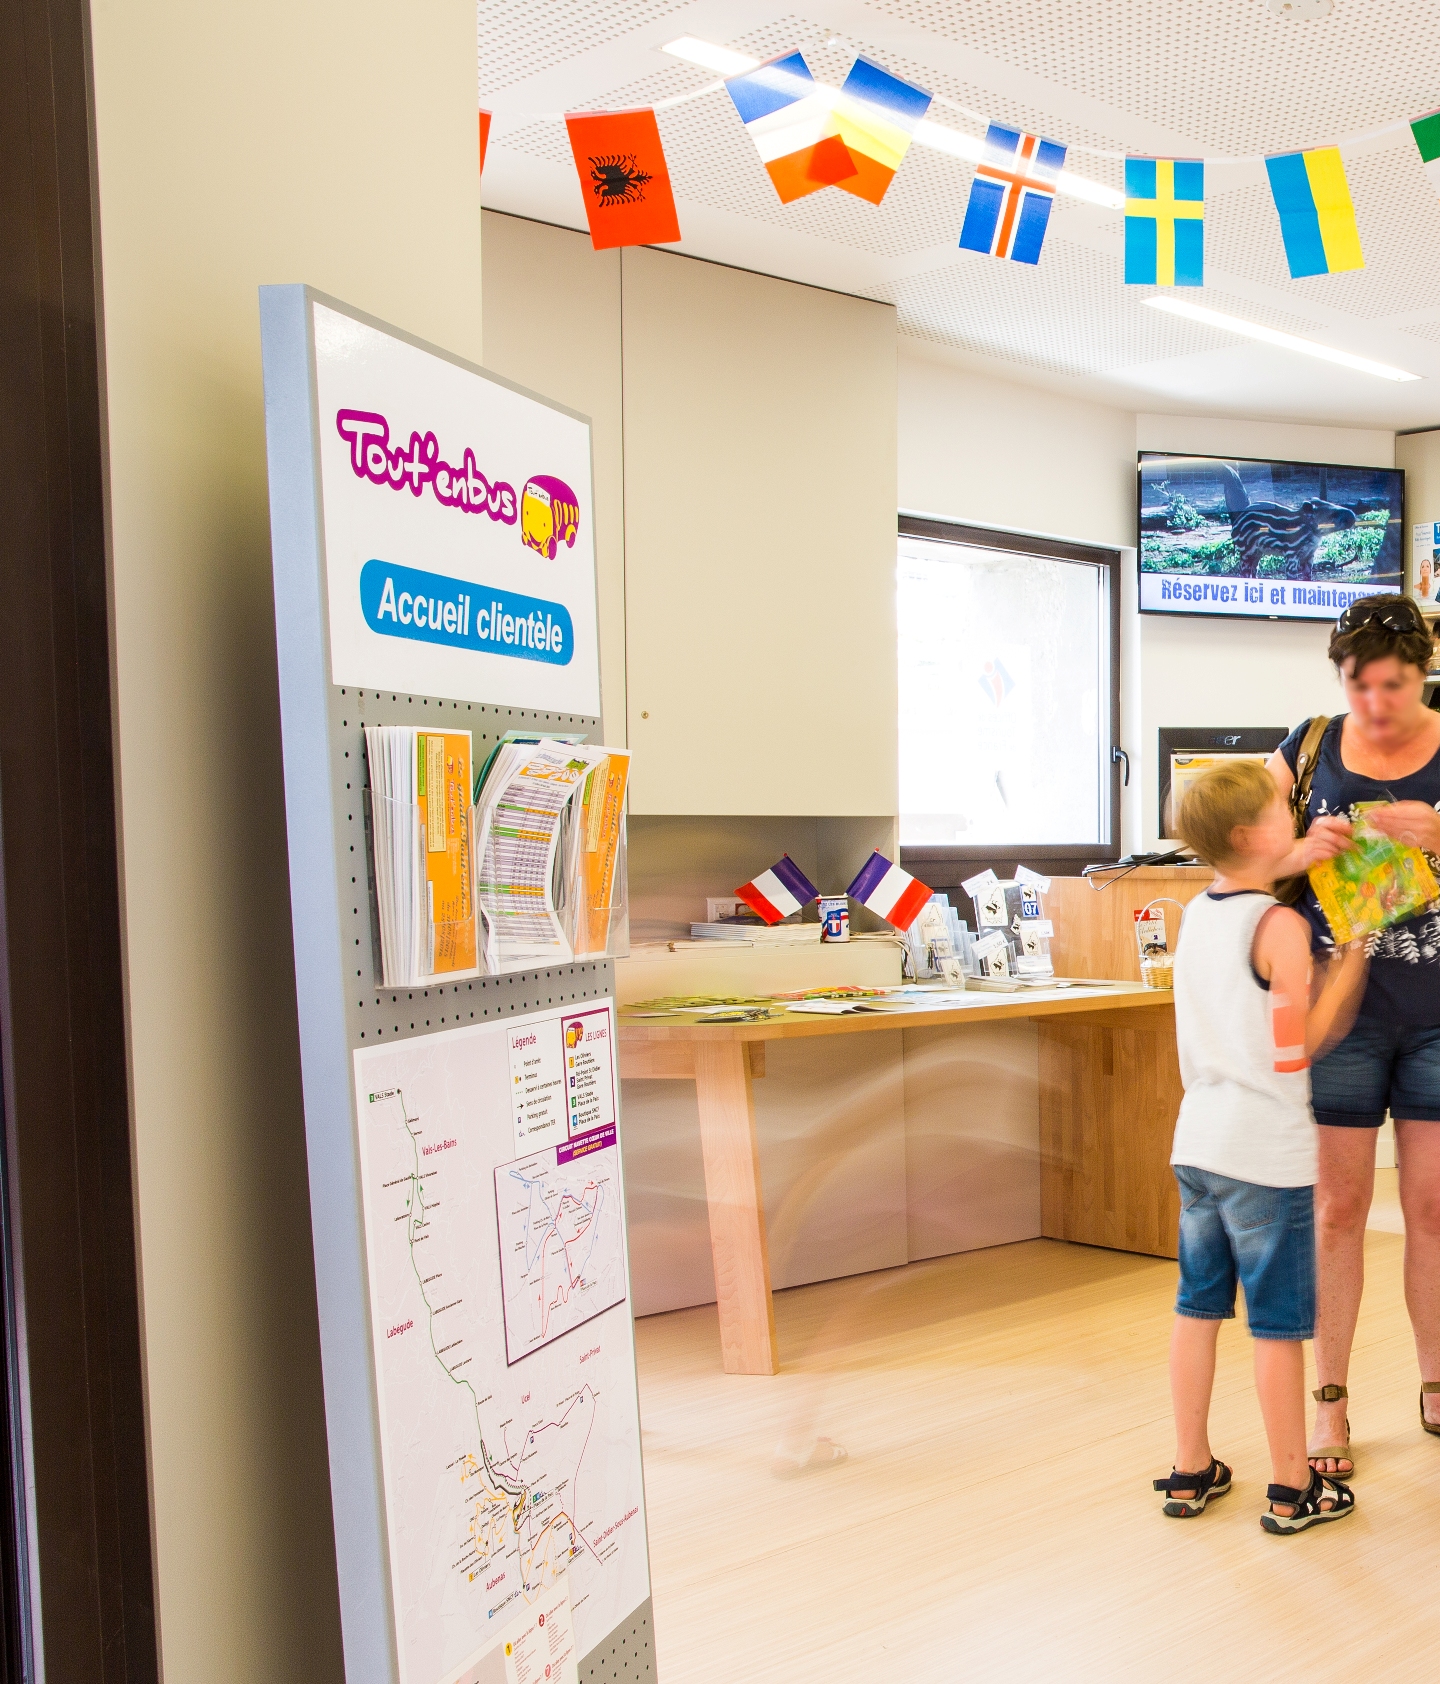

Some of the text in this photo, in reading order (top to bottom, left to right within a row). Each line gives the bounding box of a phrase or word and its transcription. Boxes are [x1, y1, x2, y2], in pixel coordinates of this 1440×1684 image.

[1161, 578, 1381, 608] Réservez ici et mainten
[377, 577, 563, 653] Accueil clientèle
[1024, 903, 1038, 916] 07
[512, 1033, 537, 1050] Légende
[585, 1029, 607, 1042] LES LIGNES
[422, 1139, 458, 1156] Vals-Les-Bains
[387, 1319, 414, 1339] Labégude
[521, 1391, 531, 1404] Ucel
[486, 1572, 506, 1592] Aubenas
